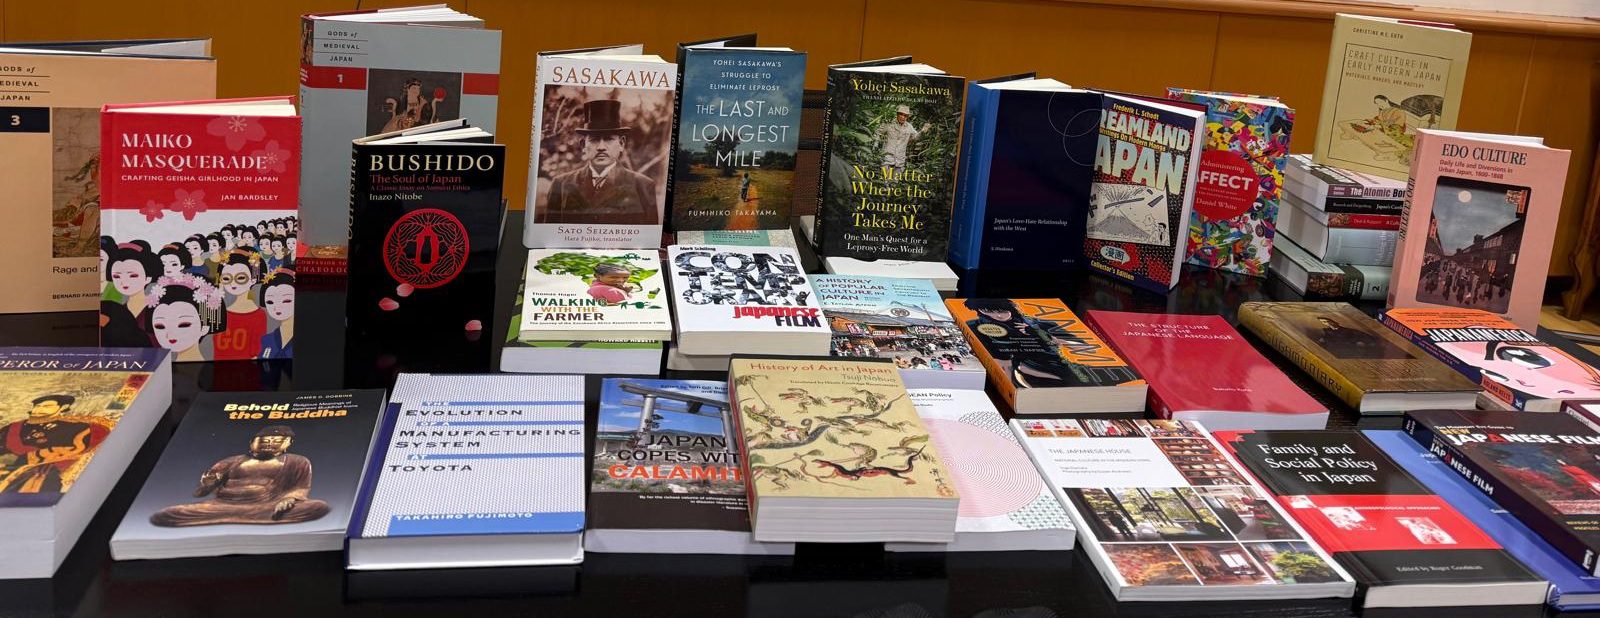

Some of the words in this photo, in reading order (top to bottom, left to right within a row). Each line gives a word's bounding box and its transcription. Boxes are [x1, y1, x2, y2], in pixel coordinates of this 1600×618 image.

[1349, 50, 1374, 62] CRAFT
[1378, 54, 1416, 68] CULTURE
[1420, 61, 1429, 70] IN
[552, 66, 670, 88] SASAKAWA
[1348, 60, 1371, 71] EARLY
[1376, 64, 1410, 78] MODERN
[1414, 71, 1441, 82] JAPAN
[337, 74, 343, 83] 1
[852, 79, 886, 95] Yohei
[890, 82, 951, 98] Sasakawa
[696, 104, 715, 115] THE
[719, 100, 766, 117] LAST
[767, 106, 789, 116] AND
[1114, 103, 1134, 114] Frederik
[1141, 110, 1160, 120] Schodt
[10, 115, 20, 126] 3
[692, 124, 790, 143] LONGEST
[121, 133, 193, 149] MAIKO
[715, 150, 762, 167] MILE
[1441, 143, 1468, 158] EDO
[1472, 147, 1528, 166] CULTURE
[121, 154, 268, 172] MASQUERADE
[370, 154, 495, 172] BUSHIDO
[1094, 134, 1186, 196] APAN
[1200, 160, 1245, 174] Administering
[1478, 164, 1506, 172] Diversions
[370, 174, 390, 184] The
[392, 174, 416, 184] Soul
[418, 174, 430, 184] of
[432, 174, 461, 186] Japan
[854, 166, 875, 180] No
[880, 167, 934, 184] Matter
[1198, 170, 1254, 190] FFECT
[370, 193, 393, 201] Inazo
[394, 193, 422, 201] Nitobe
[852, 182, 902, 199] Where
[907, 183, 932, 199] the
[857, 198, 920, 215] Journey
[1196, 198, 1217, 207] Daniel
[1218, 201, 1238, 210] White
[852, 214, 896, 229] Takes
[900, 215, 924, 231] Me
[558, 226, 583, 235] SATO
[586, 227, 640, 236] SEIZABURO
[844, 234, 860, 242] One
[862, 234, 884, 243] Man's
[886, 235, 908, 244] Quest
[910, 236, 922, 246] for
[847, 243, 899, 255] Leprosy-Free
[900, 245, 923, 254] World
[674, 251, 800, 274] CON
[52, 266, 78, 275] Rage
[80, 265, 98, 273] and
[1090, 260, 1116, 274] Collector's
[1116, 269, 1134, 280] Edition
[532, 298, 608, 307] WALKING
[533, 312, 604, 321] FARMER
[774, 315, 822, 328] FILM
[217, 327, 248, 350] GO
[1426, 328, 1540, 342] JAPANAMERICA
[1024, 302, 1138, 383] ANIME
[82, 360, 148, 370] JAPAN
[750, 363, 798, 373] History
[856, 366, 892, 374] Japan
[842, 374, 862, 382] Tsuji
[863, 375, 896, 383] Nobuo
[224, 403, 290, 412] Behold
[228, 411, 264, 420] the
[268, 409, 348, 420] Buddha
[644, 435, 726, 448] JAPAN
[617, 449, 692, 462] COPES
[700, 452, 740, 464] WIT
[1258, 443, 1318, 457] Family
[1322, 444, 1356, 454] and
[388, 464, 473, 472] TOYOTA
[1264, 457, 1320, 469] Social
[1324, 458, 1378, 471] Policy
[1430, 442, 1472, 480] JAPANESE
[1472, 474, 1494, 496] FILM
[607, 463, 744, 482] CALAMIT
[1298, 472, 1320, 482] in
[1322, 472, 1376, 484] Japan
